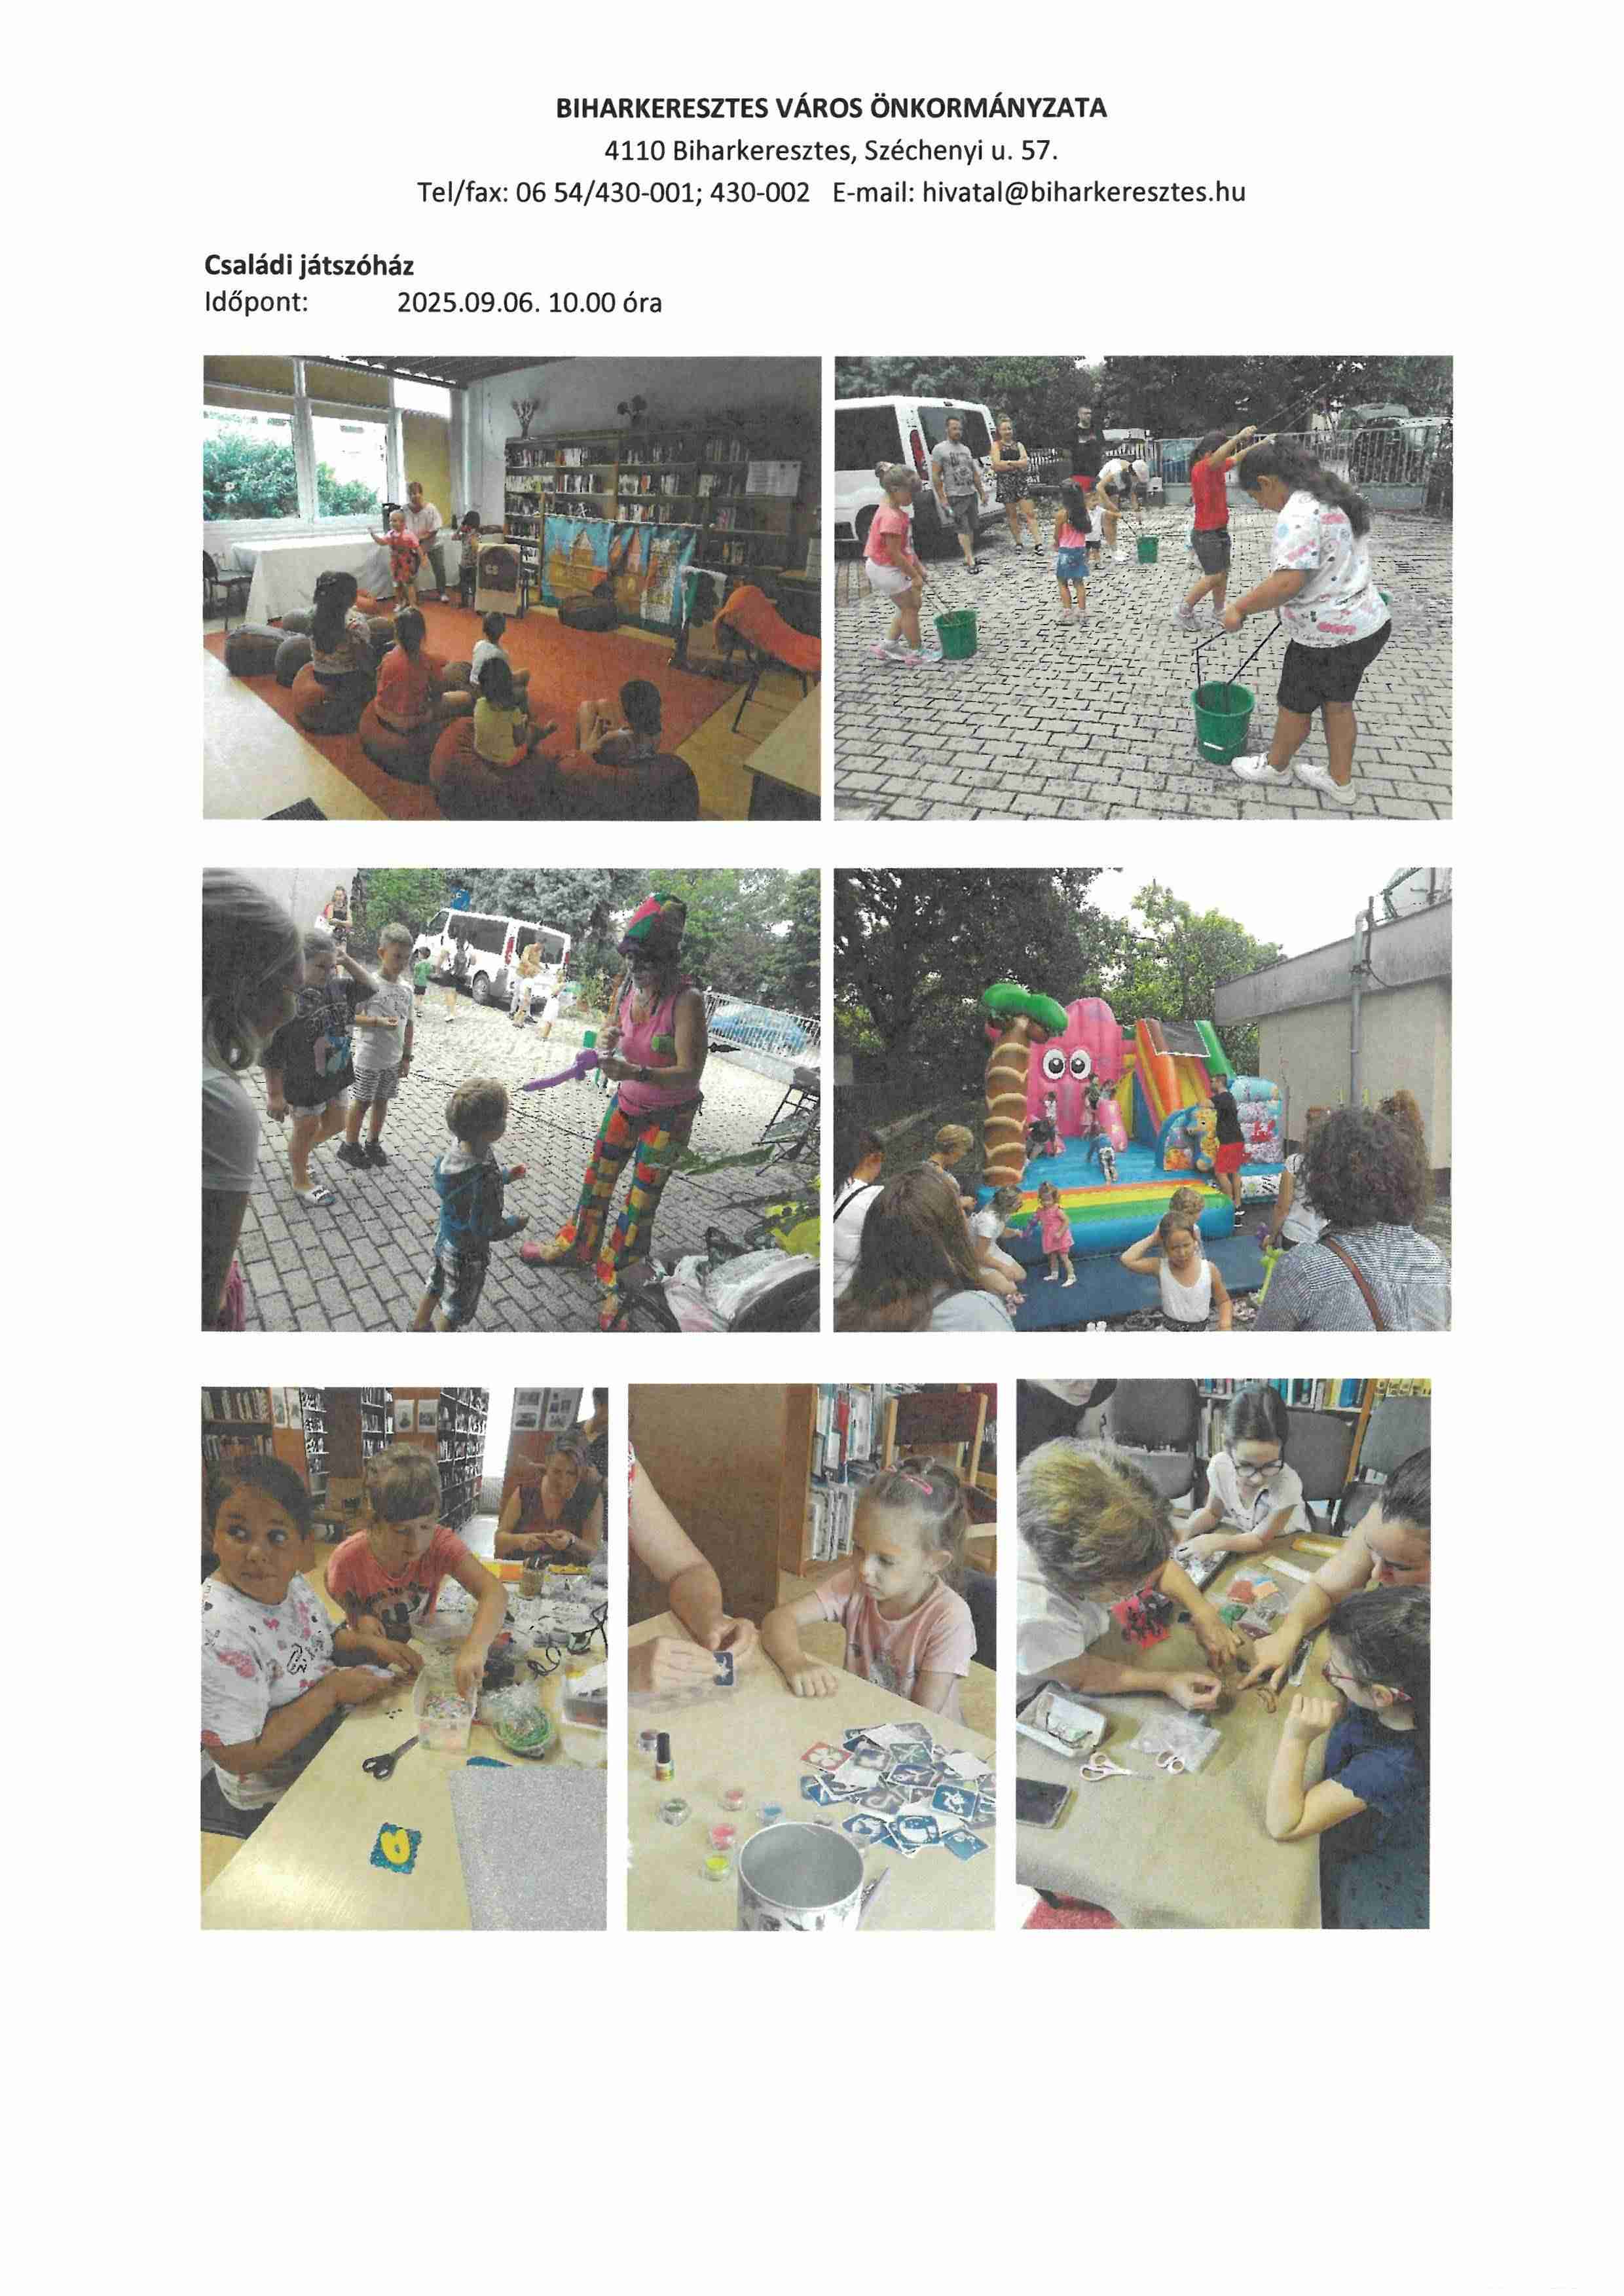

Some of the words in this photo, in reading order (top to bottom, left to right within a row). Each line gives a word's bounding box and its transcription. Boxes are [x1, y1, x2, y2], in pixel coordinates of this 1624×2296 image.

[557, 98, 769, 118] BIHARKERESZTES
[775, 92, 863, 118] VÁROS
[870, 92, 1108, 118] ÖNKORMÁNYZATA
[604, 140, 665, 161] 4110
[674, 138, 857, 165] Biharkeresztes,
[864, 138, 983, 166] Széchenyi
[992, 145, 1012, 161] u.
[1022, 139, 1058, 160] 57.
[416, 179, 508, 207] Tel/fax:
[516, 181, 546, 203] 06
[554, 179, 702, 207] 54/430-001;
[710, 181, 810, 203] 430-002
[834, 181, 914, 203] E-mail:
[923, 180, 1246, 206] hivatal@biharkeresztes.hu
[205, 253, 293, 275] Családi
[299, 253, 415, 280] játszóház
[206, 289, 308, 318] Időpont:
[397, 291, 540, 313] 2025.09.06.
[549, 292, 616, 313] 10.00
[623, 291, 662, 313] óra
